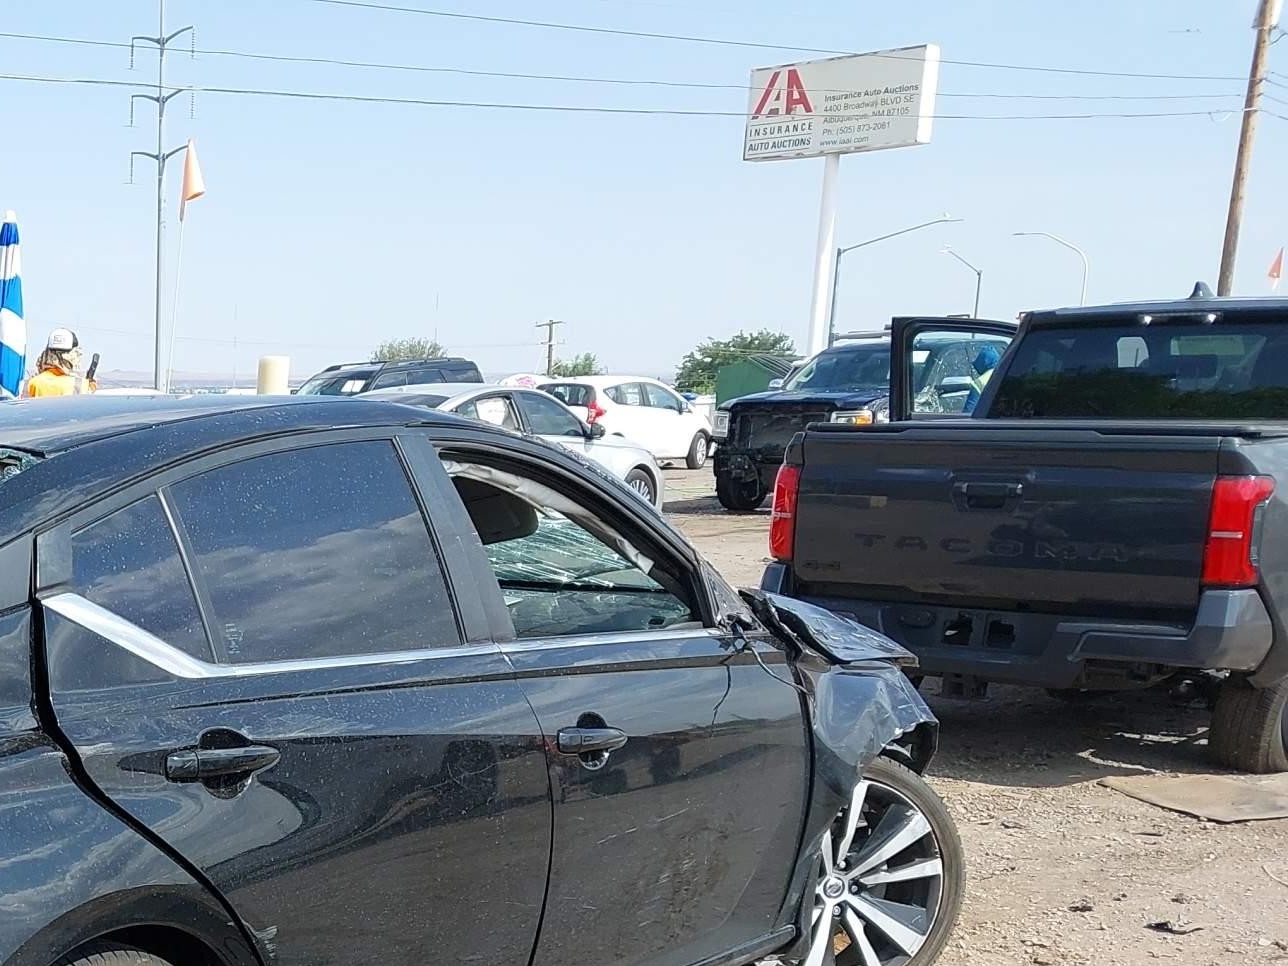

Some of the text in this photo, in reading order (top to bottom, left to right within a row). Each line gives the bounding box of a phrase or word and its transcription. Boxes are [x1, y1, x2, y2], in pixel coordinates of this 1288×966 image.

[824, 83, 920, 102] Insurance Auto Auctions
[823, 93, 915, 113] 4400 Broadway BLVD SE
[749, 121, 813, 138] INSURANCE
[748, 136, 812, 153] AUTO AUCTIONS
[853, 532, 1129, 562] TACOMA
